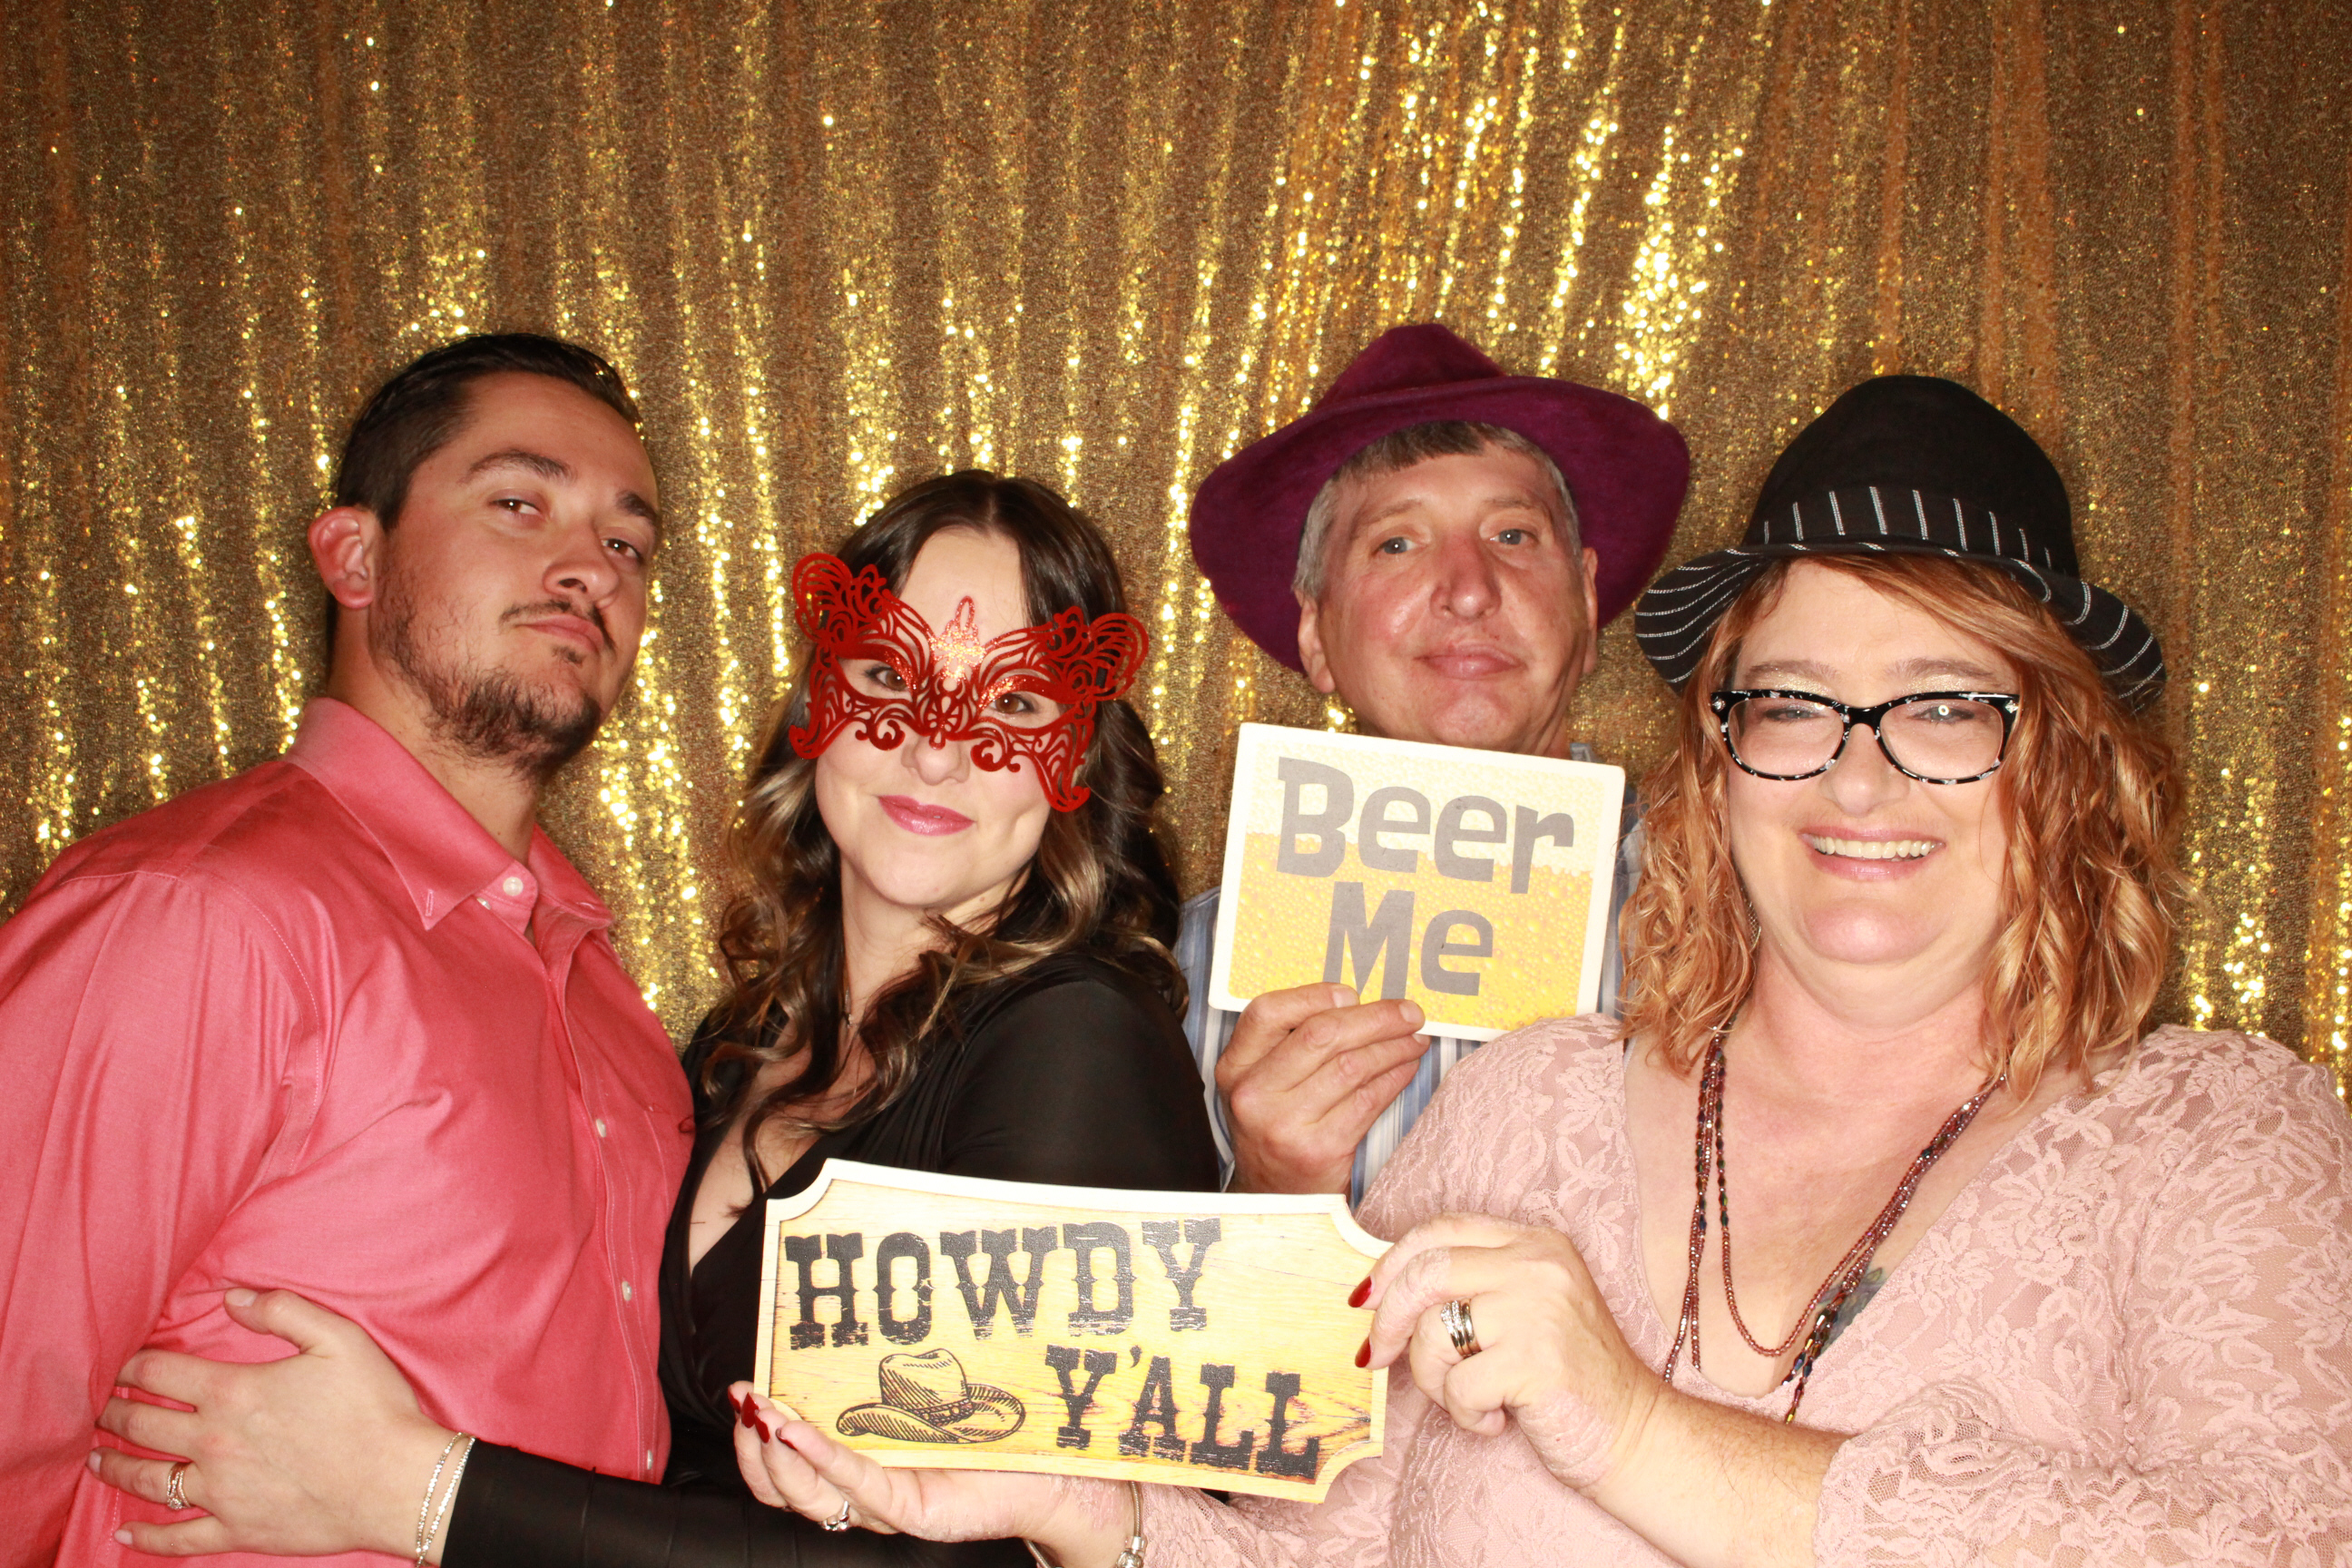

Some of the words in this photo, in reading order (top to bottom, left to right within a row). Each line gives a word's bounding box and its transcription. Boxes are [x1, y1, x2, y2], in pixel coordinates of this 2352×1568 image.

[1277, 756, 1574, 894] Beer
[1322, 881, 1494, 1000] Me
[784, 1217, 1221, 1350] HOWDY
[1044, 1344, 1321, 1480] Y'ALL
